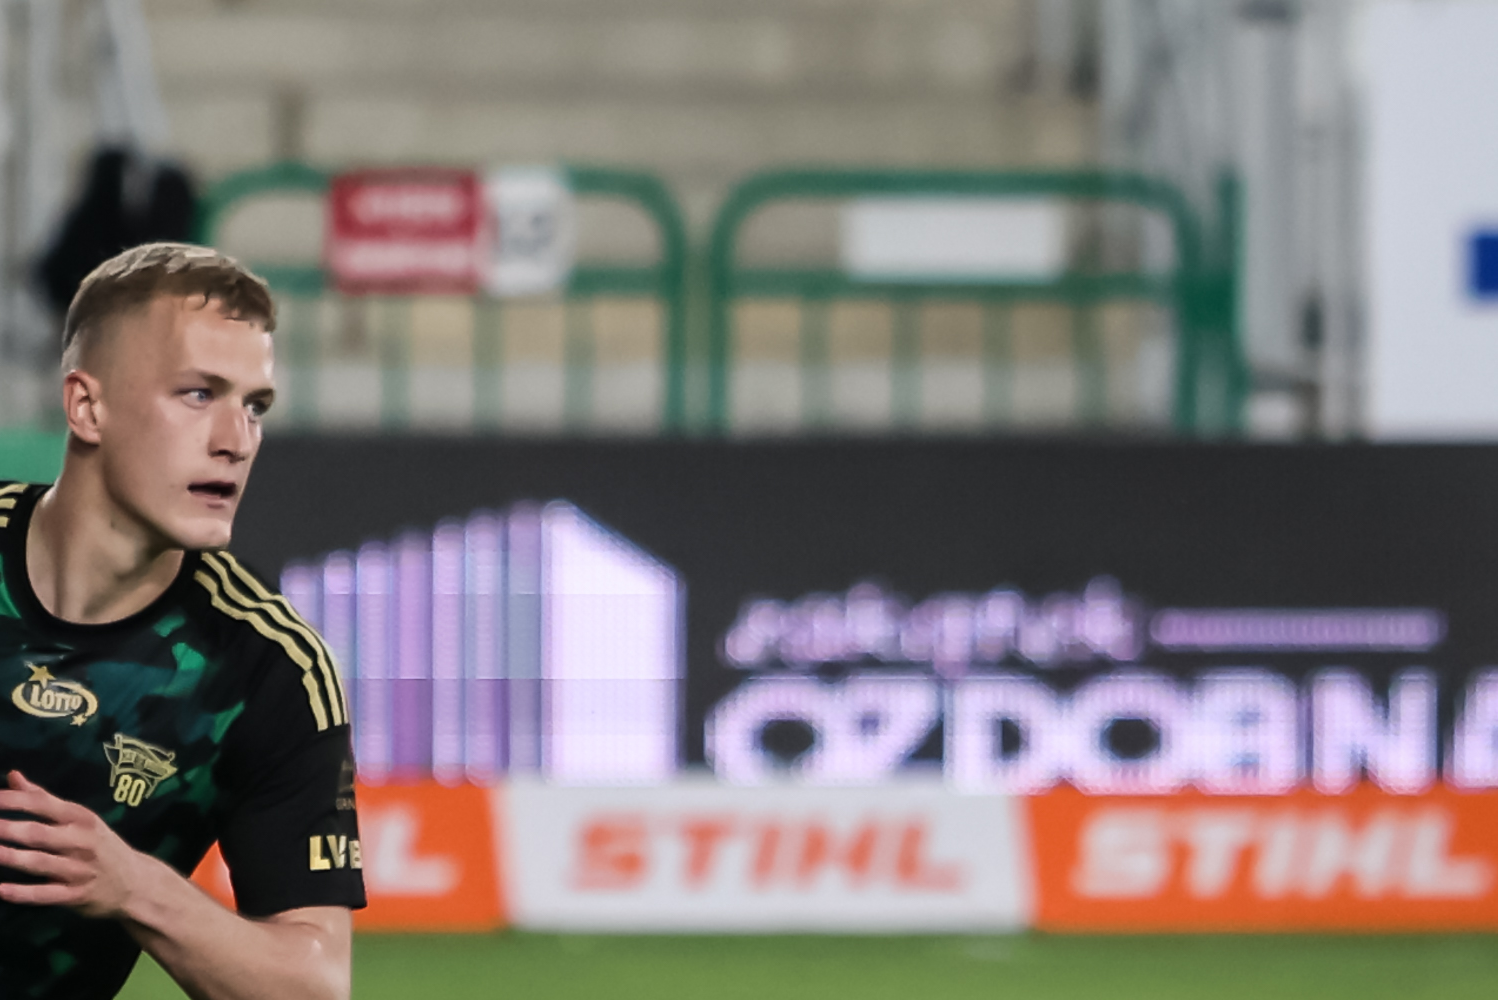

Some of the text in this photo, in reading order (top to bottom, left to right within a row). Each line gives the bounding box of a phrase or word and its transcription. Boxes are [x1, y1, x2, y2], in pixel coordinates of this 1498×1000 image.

[30, 684, 83, 711] LOTTO
[113, 774, 146, 807] 80
[567, 808, 964, 895] STIHL
[1070, 800, 1494, 898] STIHL
